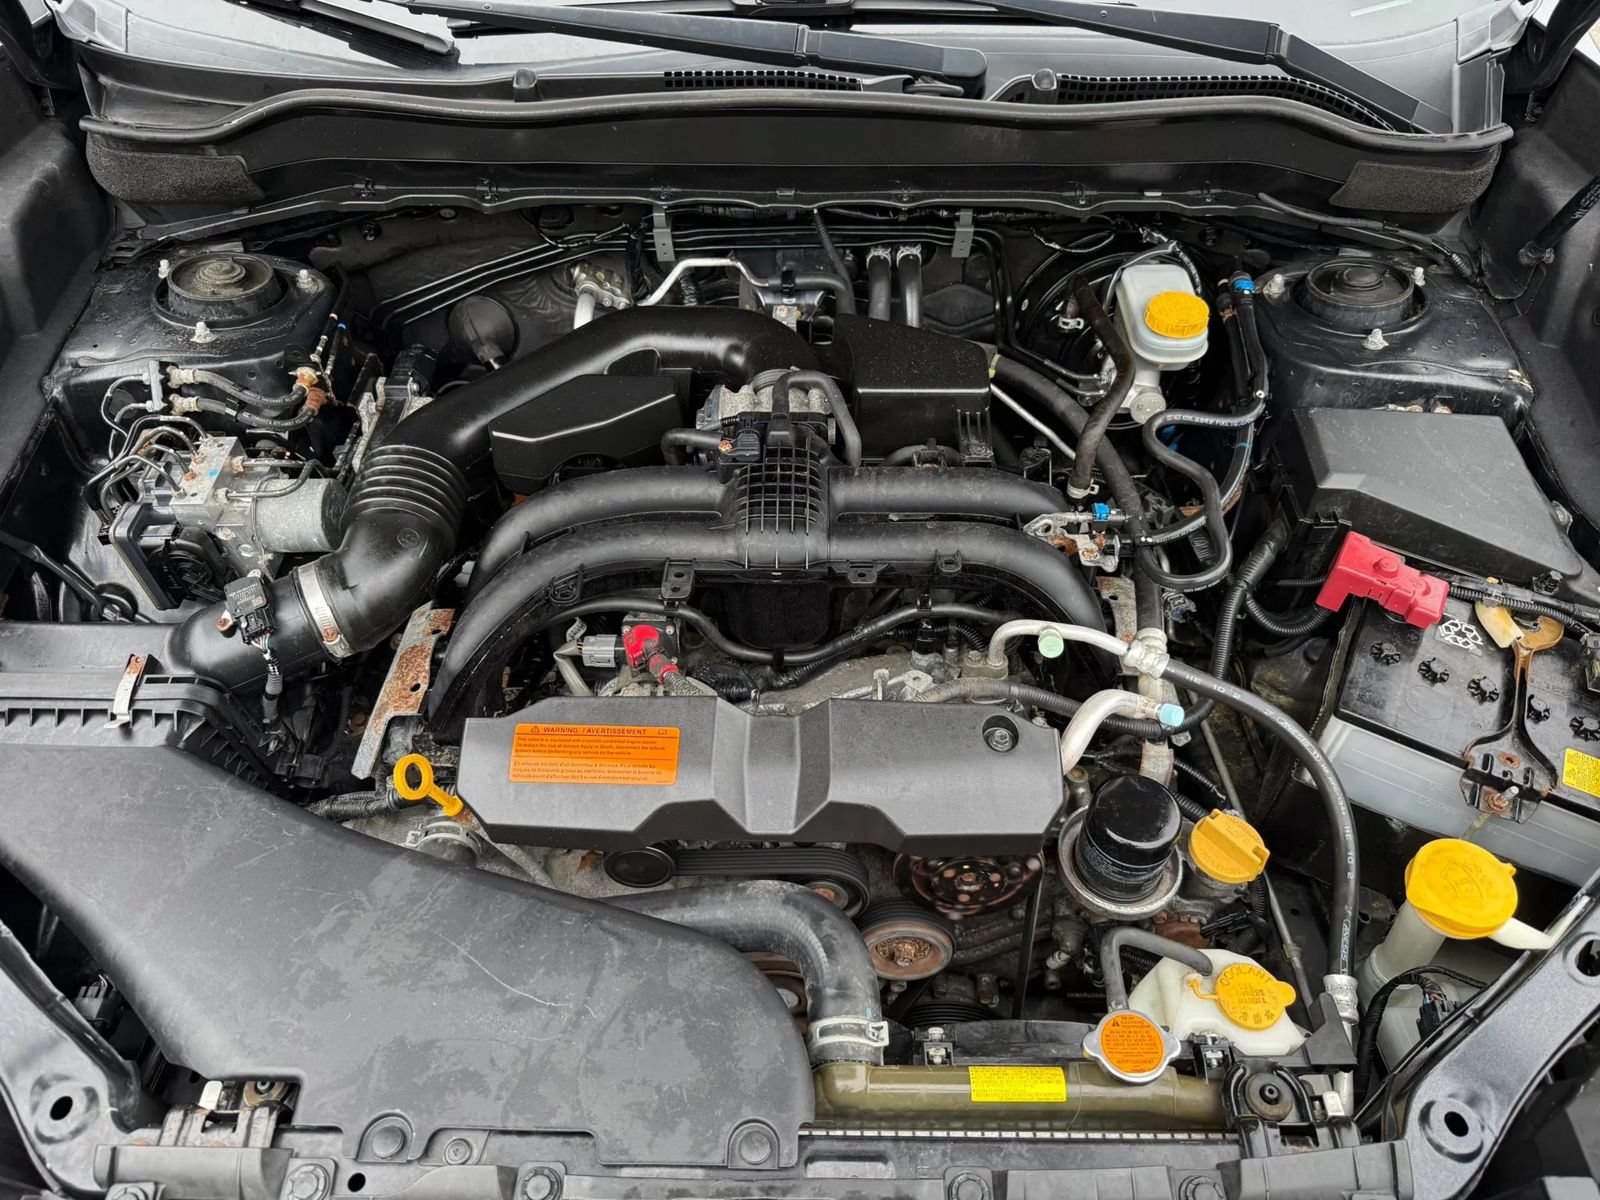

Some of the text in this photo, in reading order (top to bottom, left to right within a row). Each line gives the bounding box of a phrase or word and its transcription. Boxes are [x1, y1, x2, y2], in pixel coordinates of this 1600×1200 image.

[1185, 674, 1203, 685] HE
[543, 726, 578, 734] WARNING
[586, 727, 647, 735] AVERTISSEMENT
